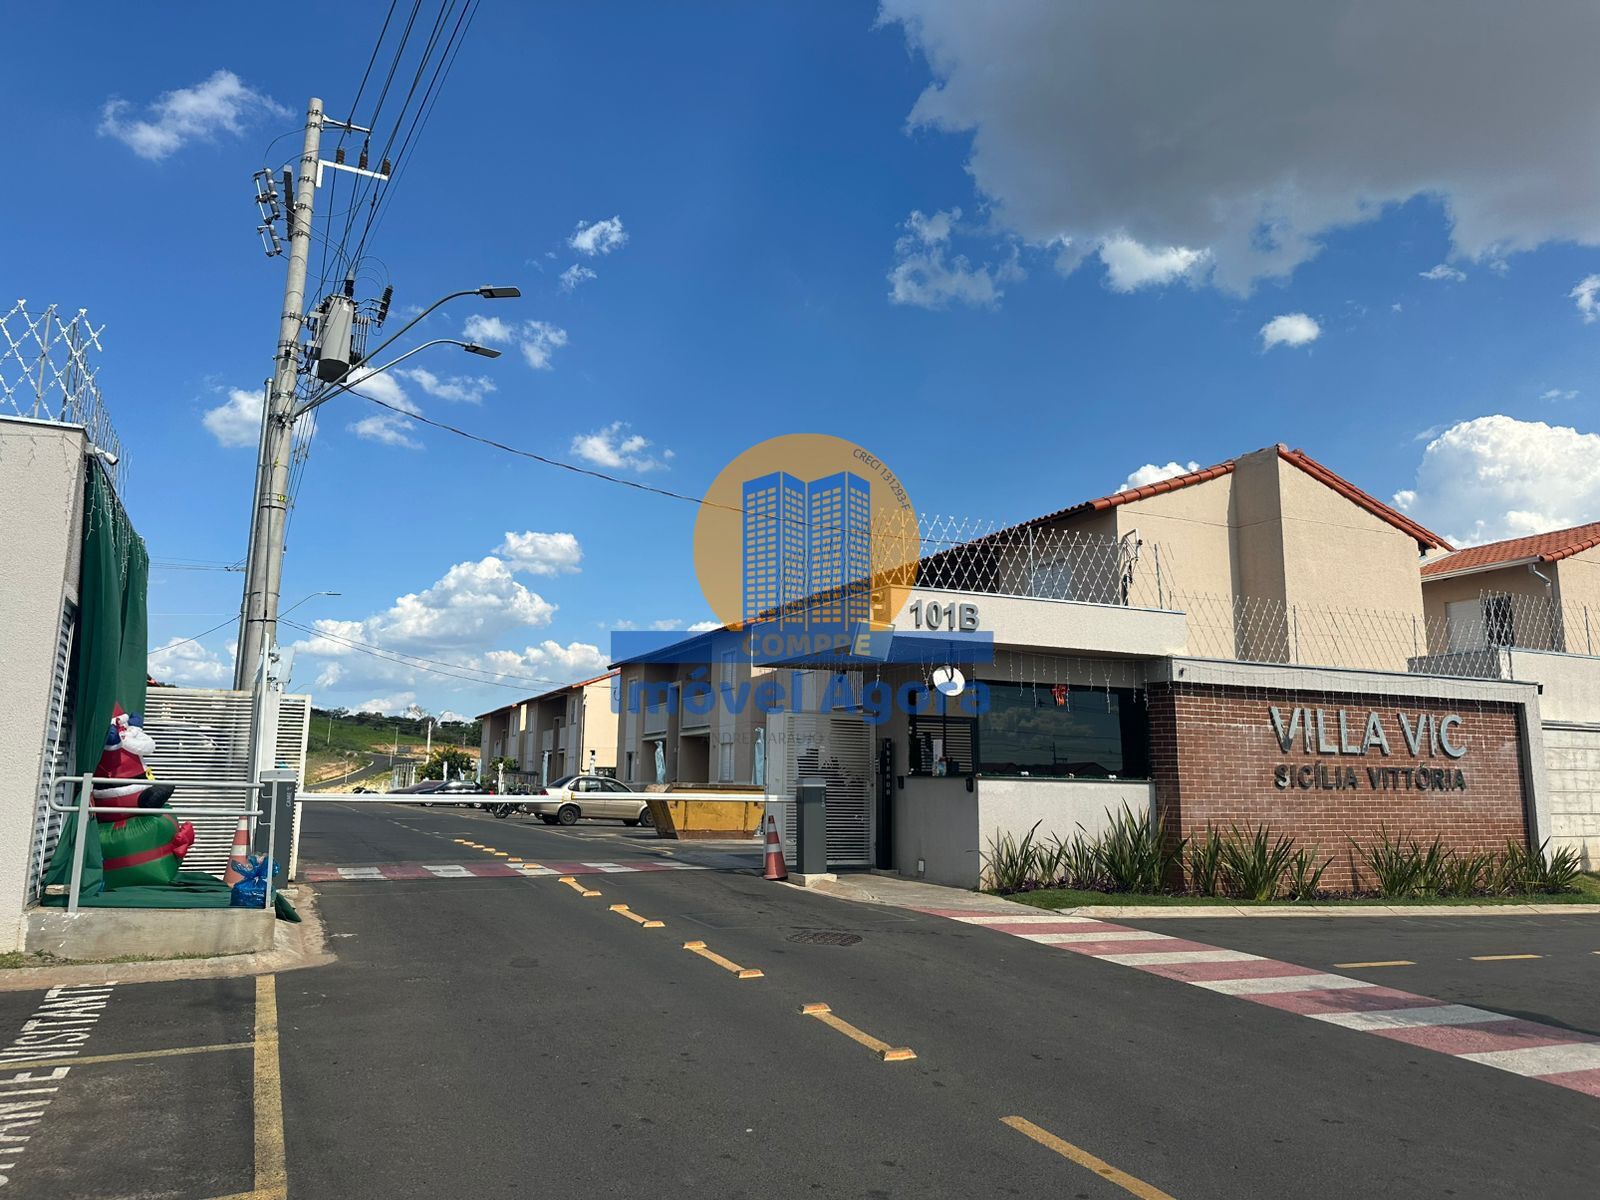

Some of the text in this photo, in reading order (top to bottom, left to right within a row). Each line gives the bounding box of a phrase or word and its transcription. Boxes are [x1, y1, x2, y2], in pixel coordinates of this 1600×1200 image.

[909, 599, 980, 633] 101B
[1269, 706, 1467, 758] VILLA VIC
[1273, 760, 1467, 792] SICÍLIA VITTÓRIA
